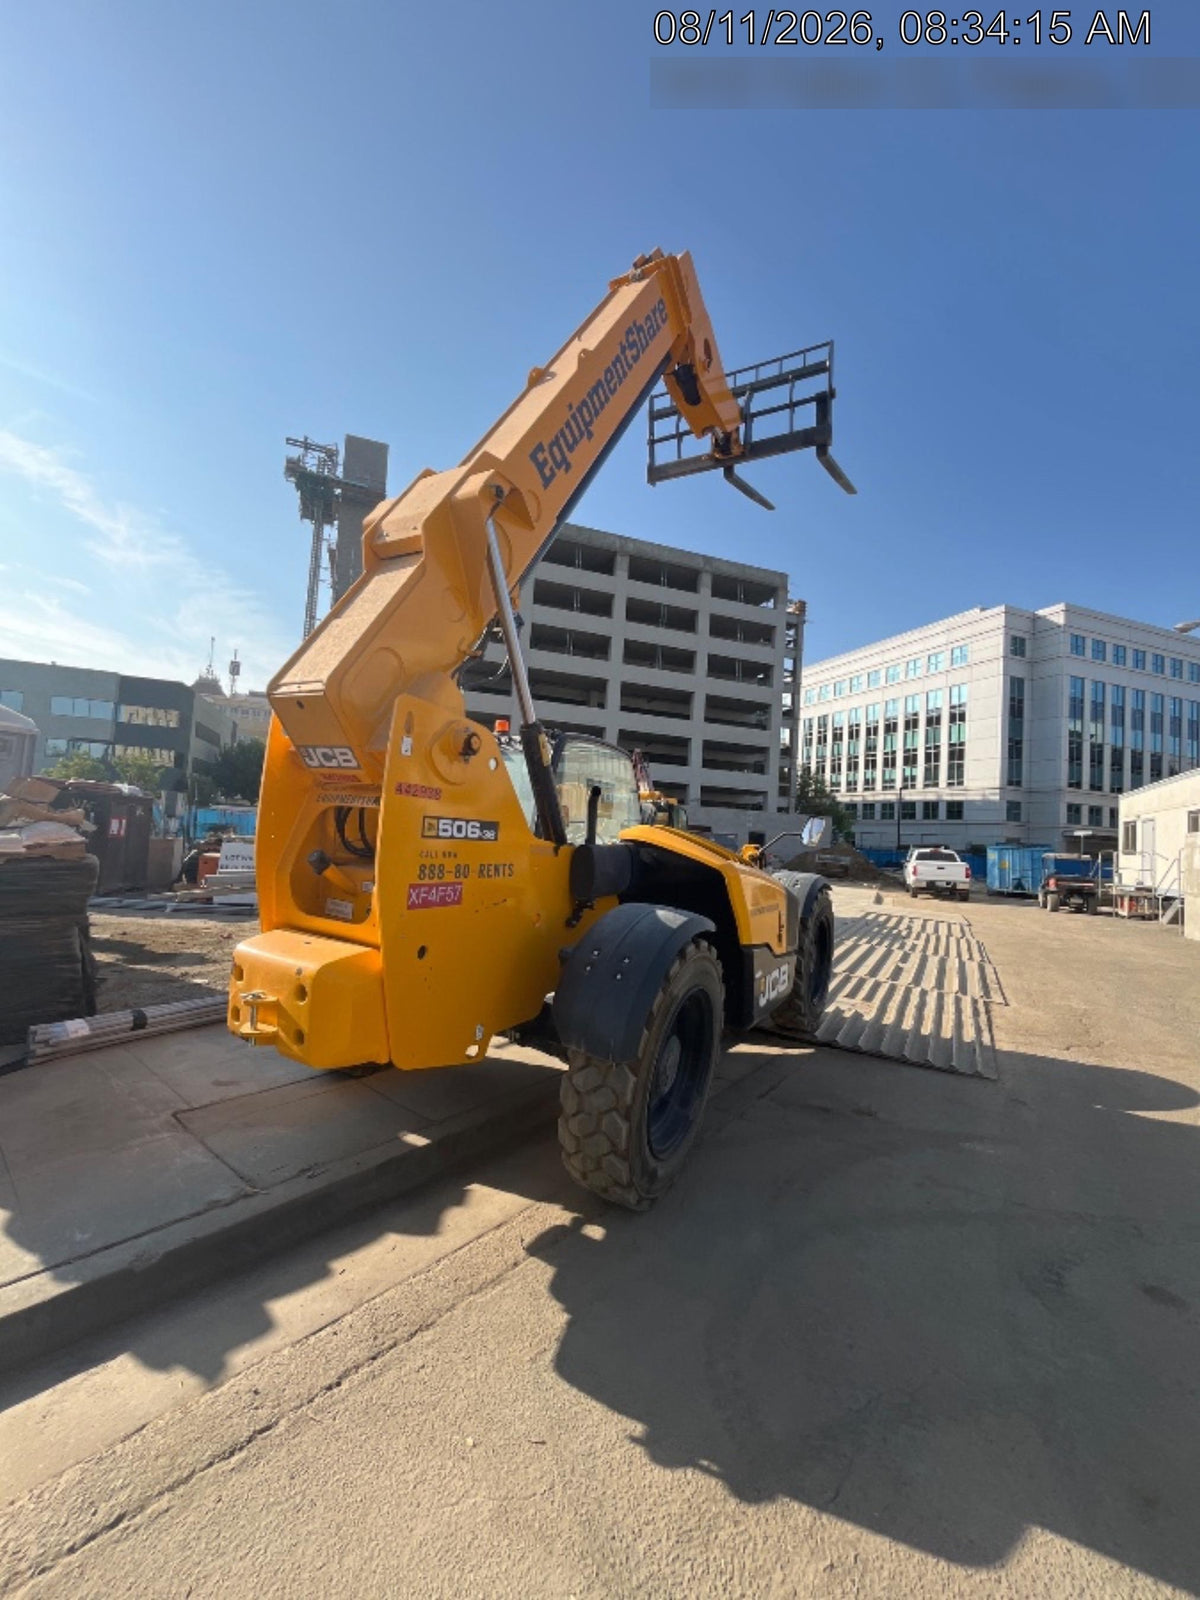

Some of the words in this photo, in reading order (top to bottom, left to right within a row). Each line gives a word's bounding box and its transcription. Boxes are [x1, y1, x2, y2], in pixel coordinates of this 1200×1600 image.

[528, 298, 668, 490] EquipmentShare
[303, 747, 359, 768] JCB
[418, 863, 470, 881] 888-80
[477, 863, 514, 879] RENTS
[408, 884, 463, 905] XF4F57
[758, 963, 789, 1008] JCB
